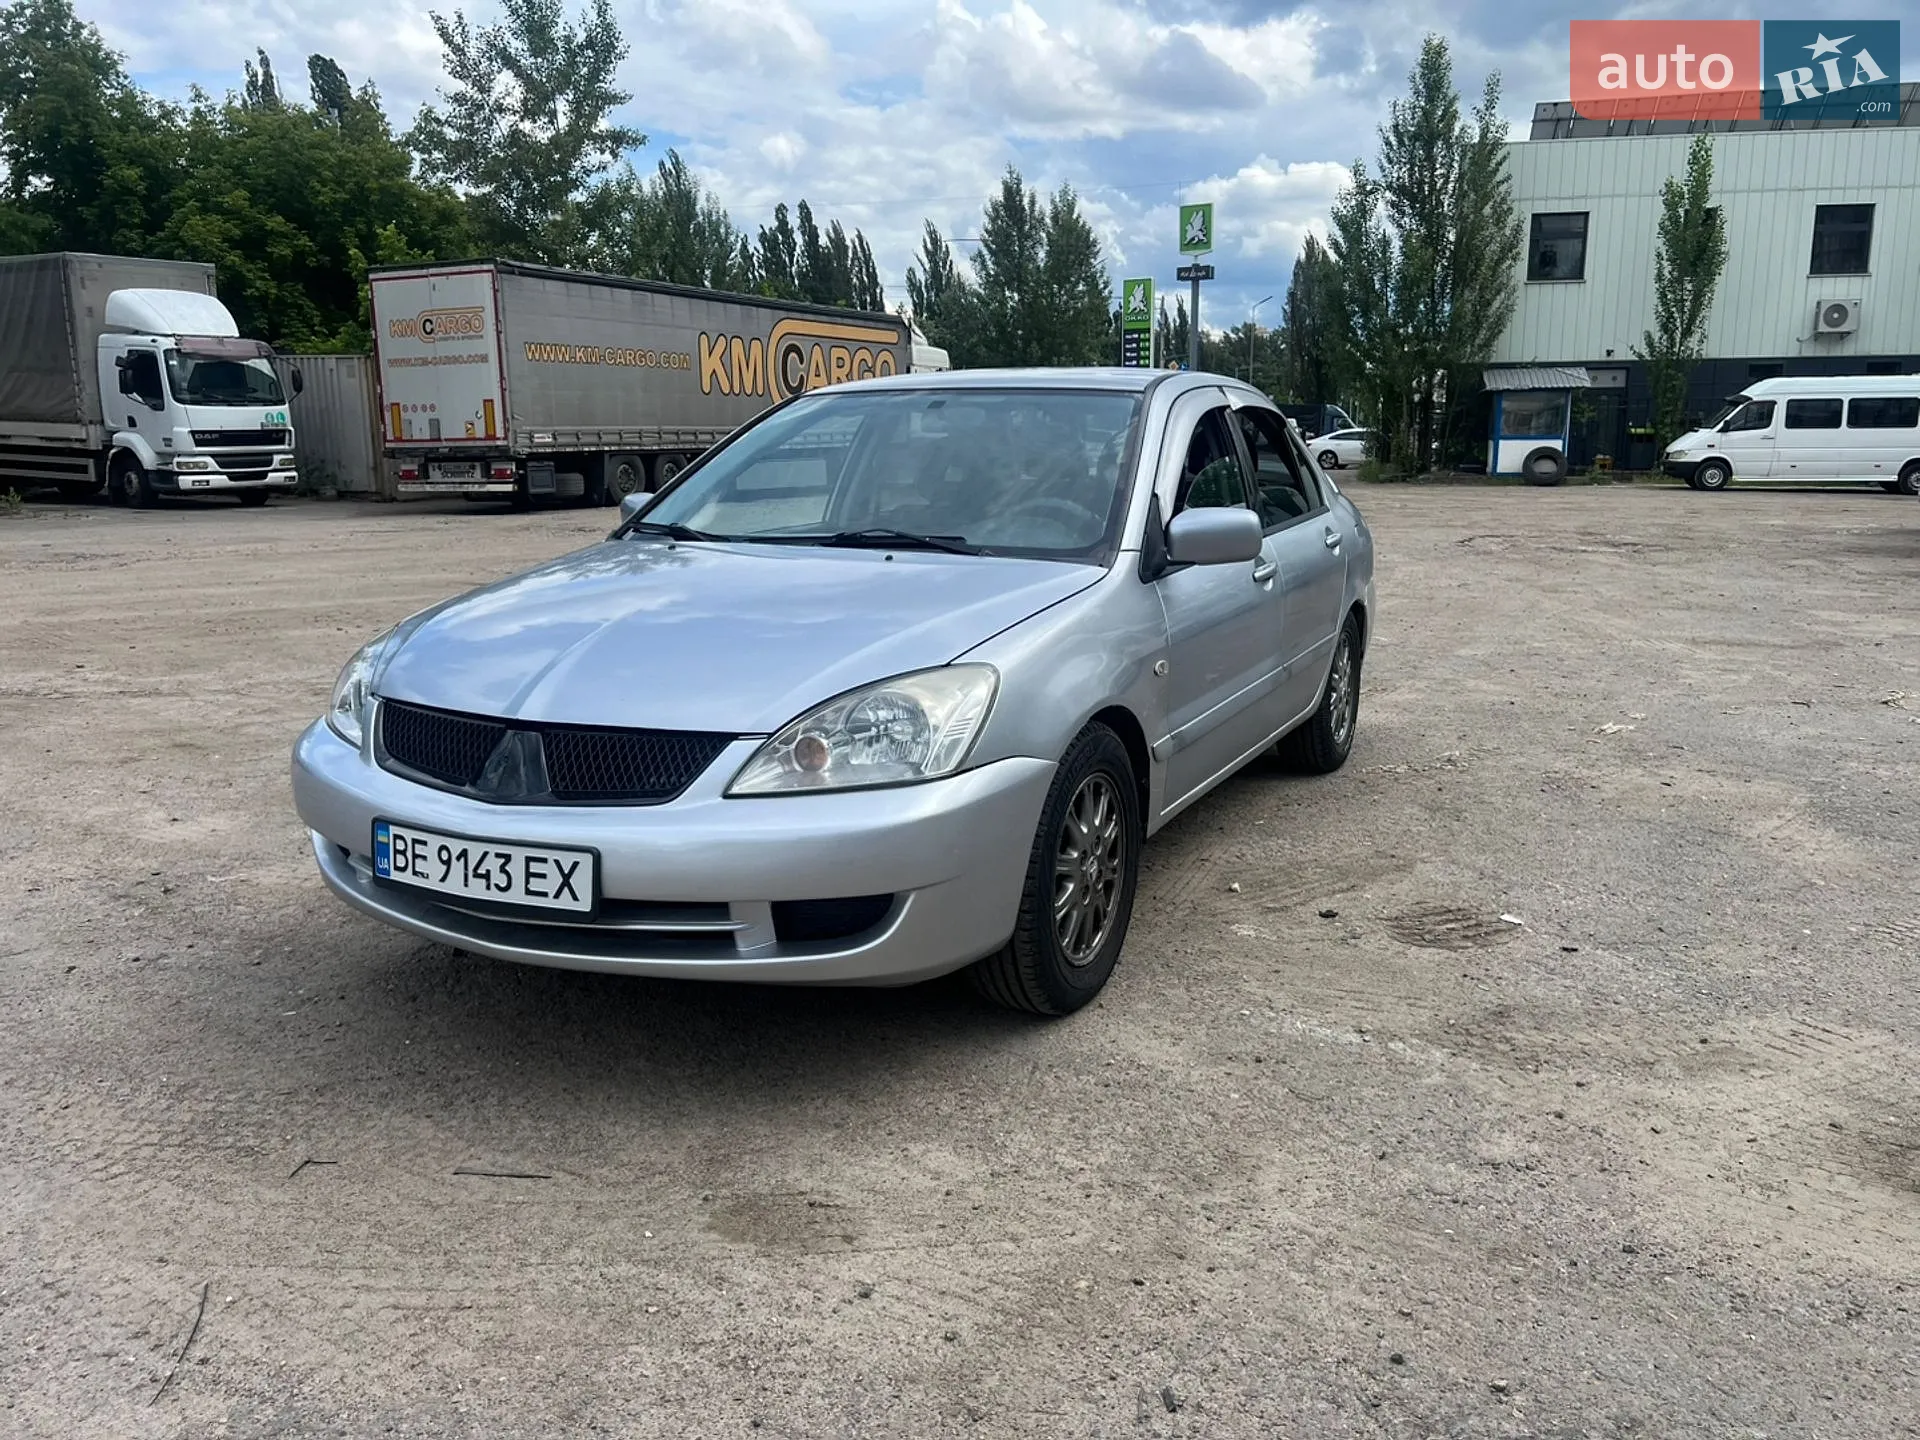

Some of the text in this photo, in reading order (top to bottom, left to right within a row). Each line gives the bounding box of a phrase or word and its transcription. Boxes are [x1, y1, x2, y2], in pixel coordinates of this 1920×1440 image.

[389, 313, 485, 338] KM CARGO
[524, 342, 692, 371] WWW.KM-CARGO.COM
[698, 331, 764, 397] KM
[377, 857, 389, 871] UA
[392, 834, 581, 902] BE 9143 EX
